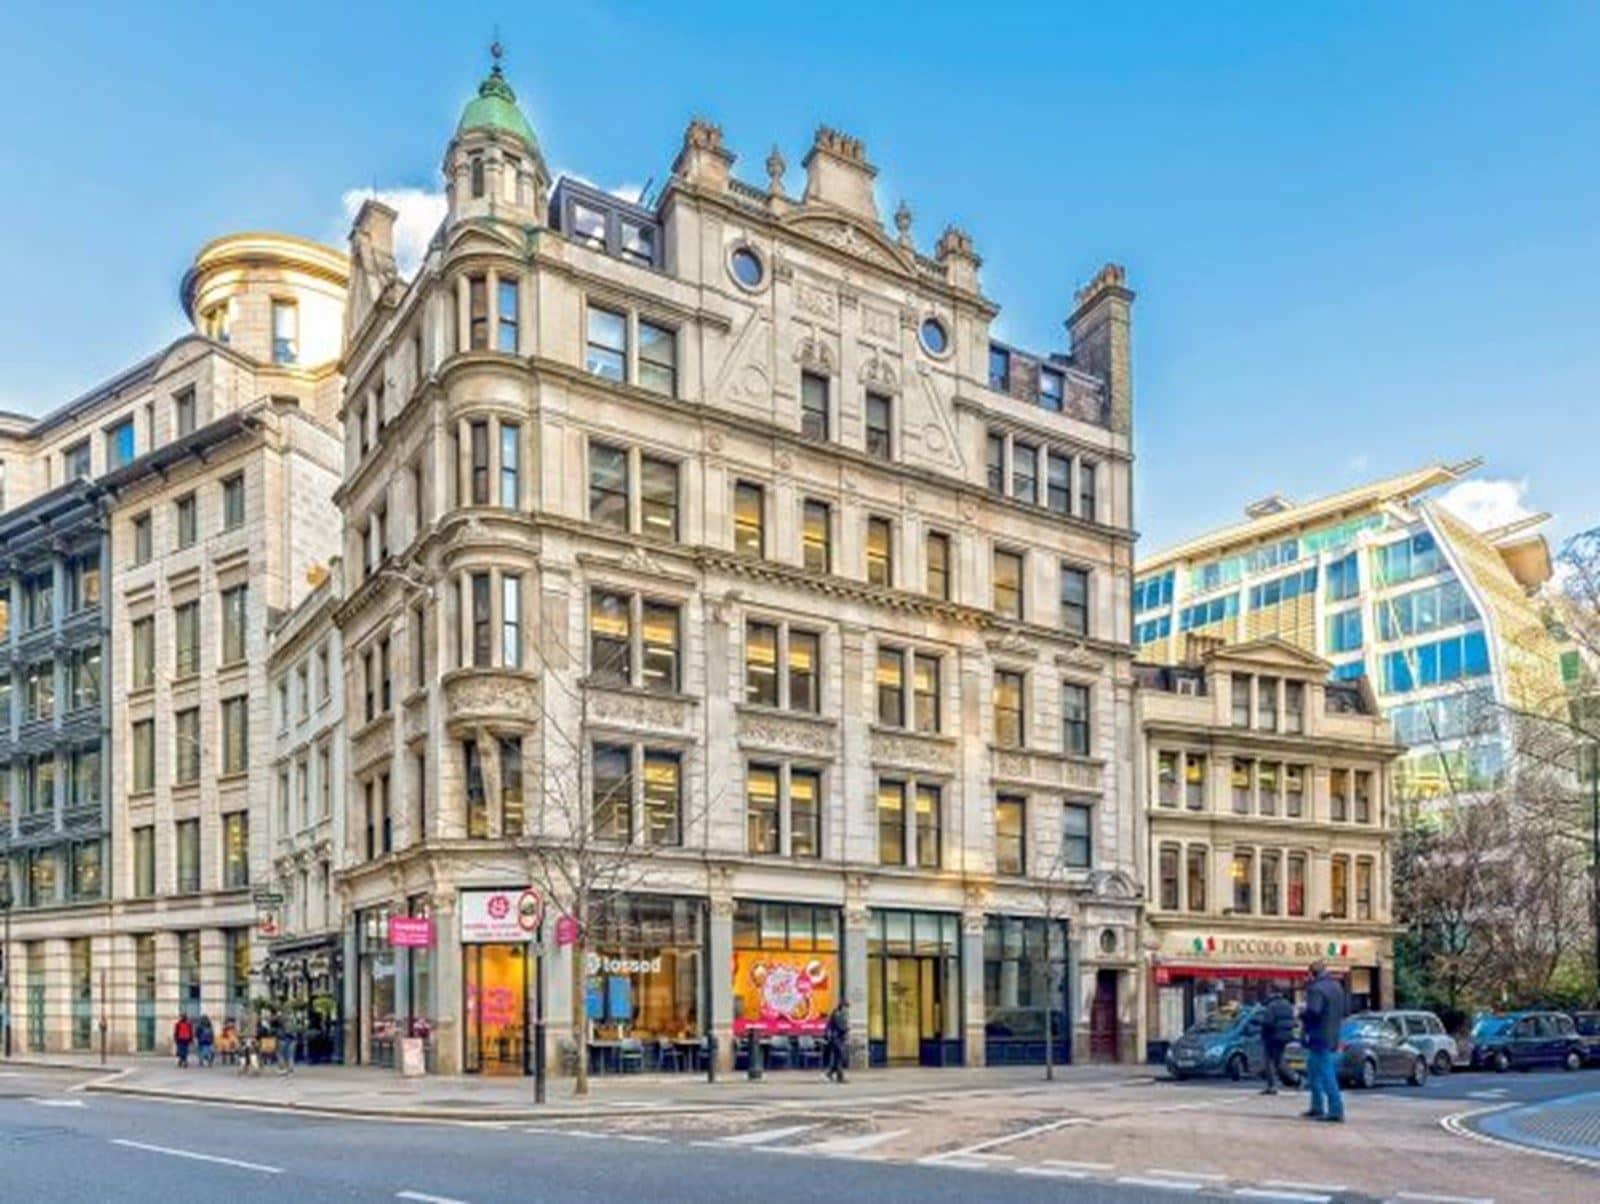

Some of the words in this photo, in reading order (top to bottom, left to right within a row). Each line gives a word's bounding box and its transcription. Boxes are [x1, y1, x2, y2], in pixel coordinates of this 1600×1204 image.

[1222, 938, 1286, 956] PICCOLO
[1295, 941, 1322, 956] BAR
[603, 955, 661, 973] tossed
